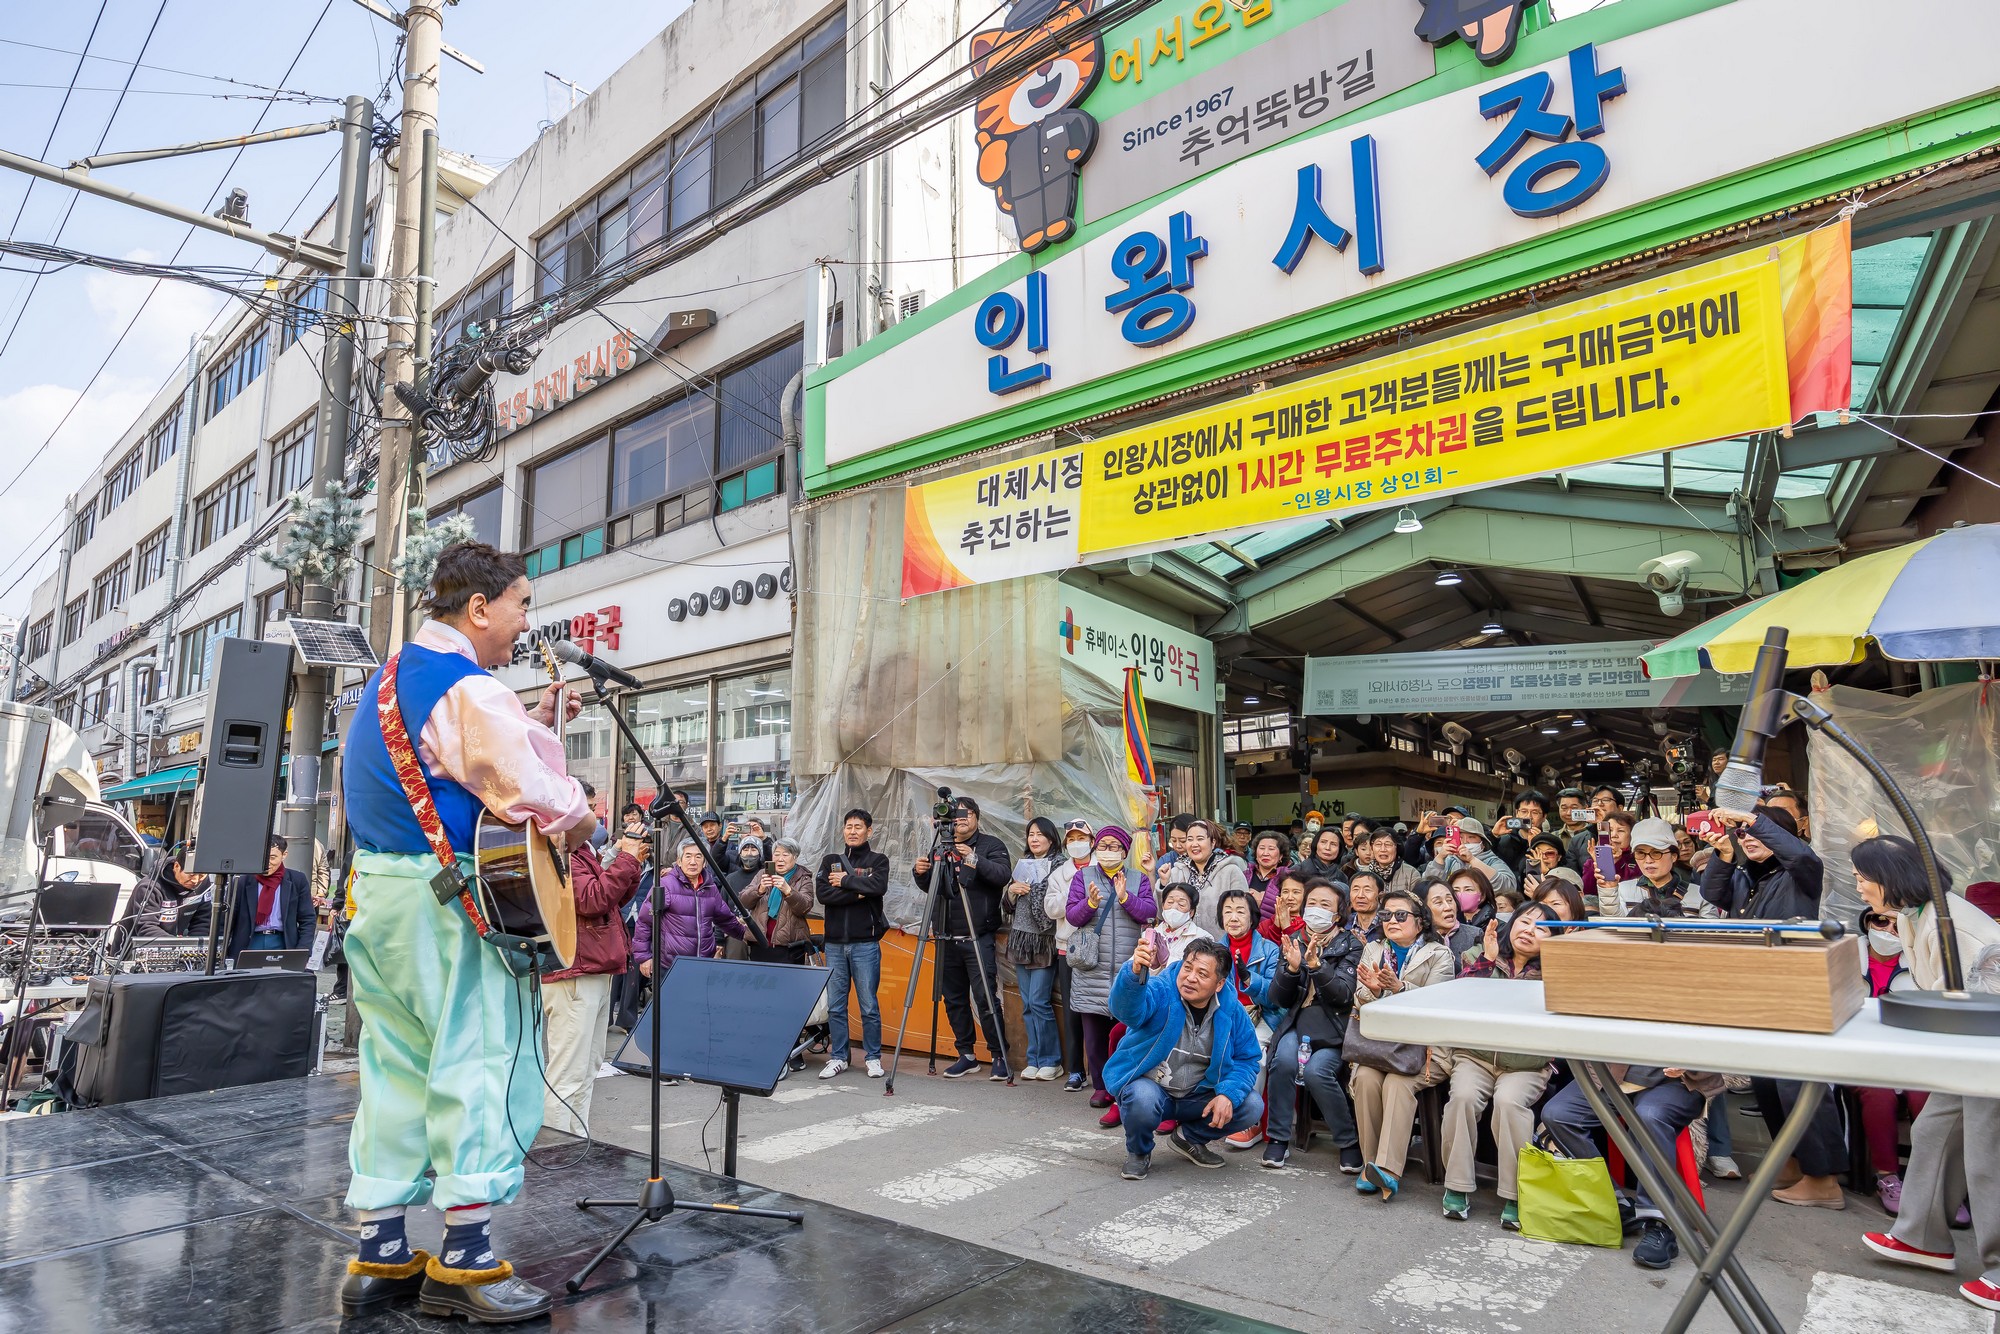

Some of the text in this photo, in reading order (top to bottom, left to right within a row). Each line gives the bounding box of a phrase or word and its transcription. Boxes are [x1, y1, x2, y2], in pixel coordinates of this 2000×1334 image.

[1179, 48, 1376, 167] 추억뚝방길
[975, 42, 1628, 395] 인왕시장
[681, 313, 696, 326] 2F
[497, 327, 638, 431] 직영 자재 전시장
[1103, 290, 1741, 481] 인왕시장에서 구매한 고객분들께는 구매금액에
[1133, 367, 1680, 515] 상관없이 1시간 무료주차권을 드립니다.
[960, 505, 1071, 555] 추진하는
[1085, 626, 1129, 659] 휴베이스
[757, 792, 792, 808] 안녕하세요
